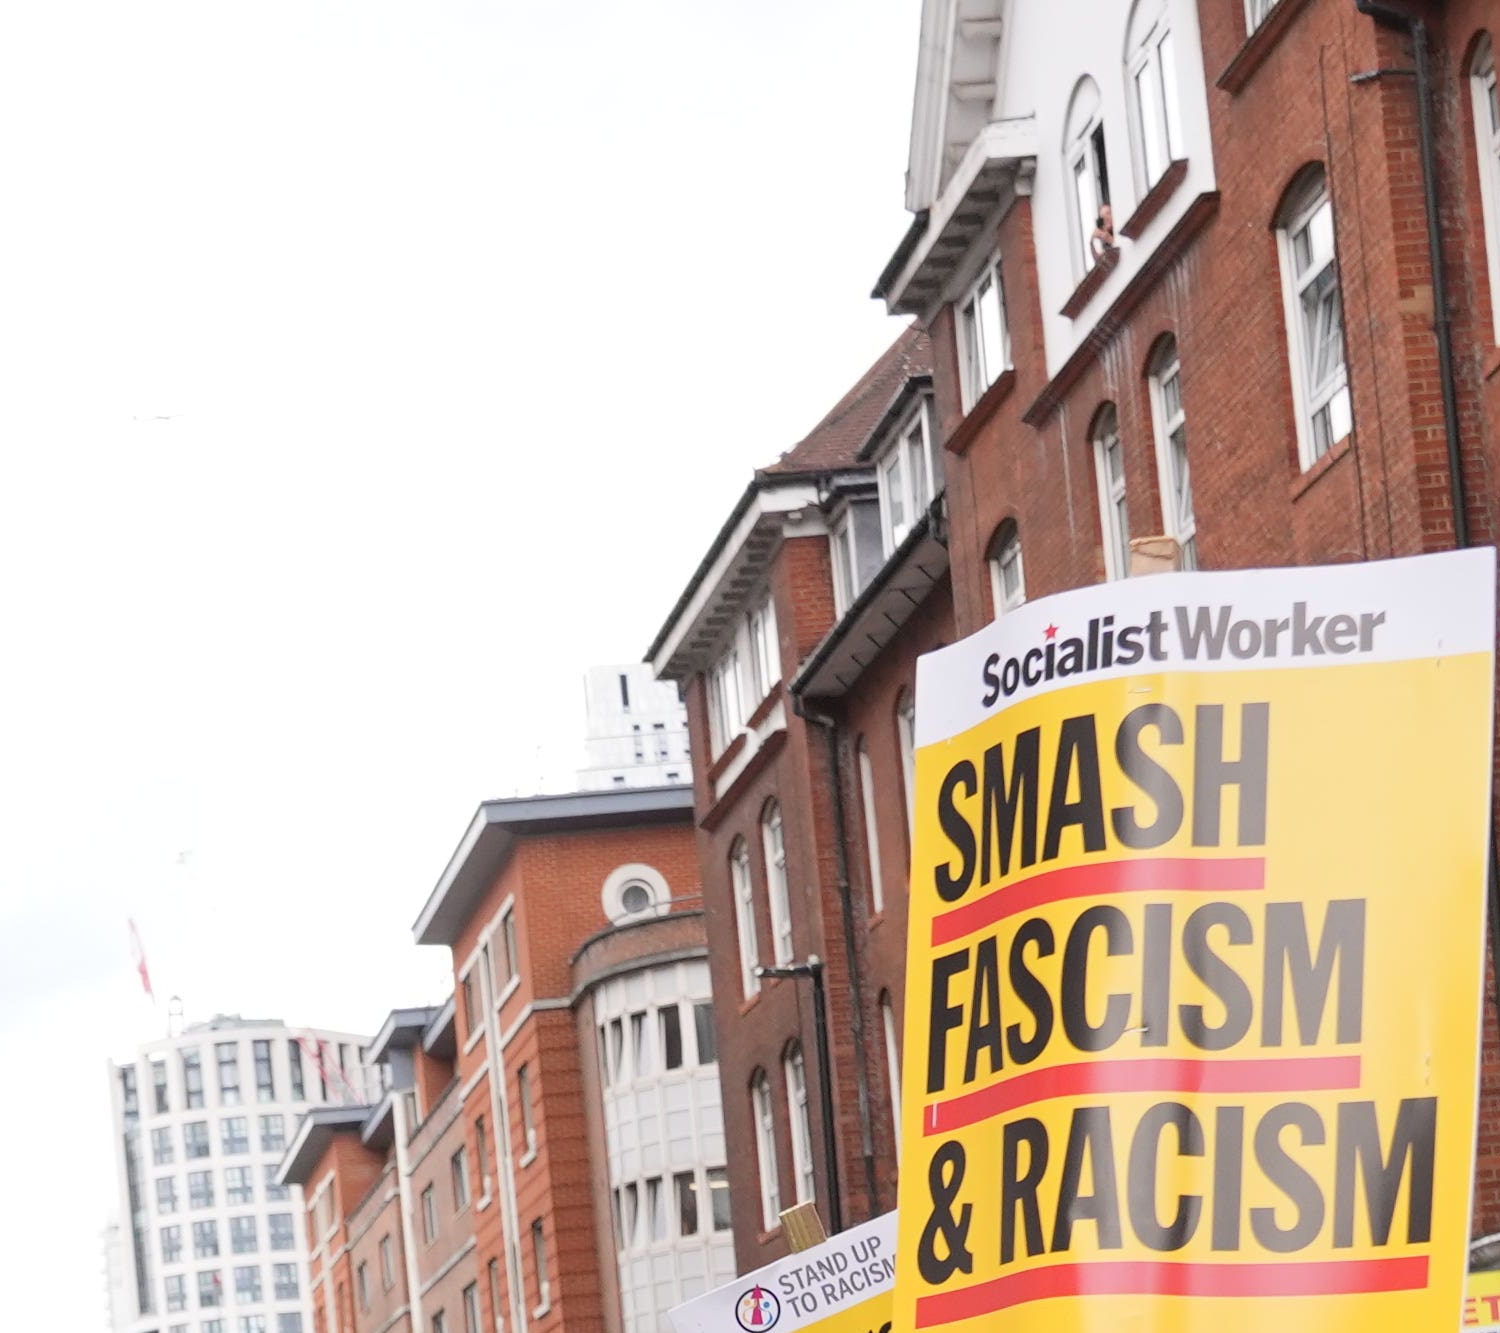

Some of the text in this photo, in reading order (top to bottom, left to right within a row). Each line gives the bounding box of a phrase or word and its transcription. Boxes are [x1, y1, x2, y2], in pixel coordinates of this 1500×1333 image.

[934, 701, 1269, 903] SMASH
[927, 898, 1367, 1093] FASCISM
[778, 1236, 882, 1295] STAND UP
[917, 1096, 1438, 1285] & RACISM
[787, 1292, 818, 1319] TO
